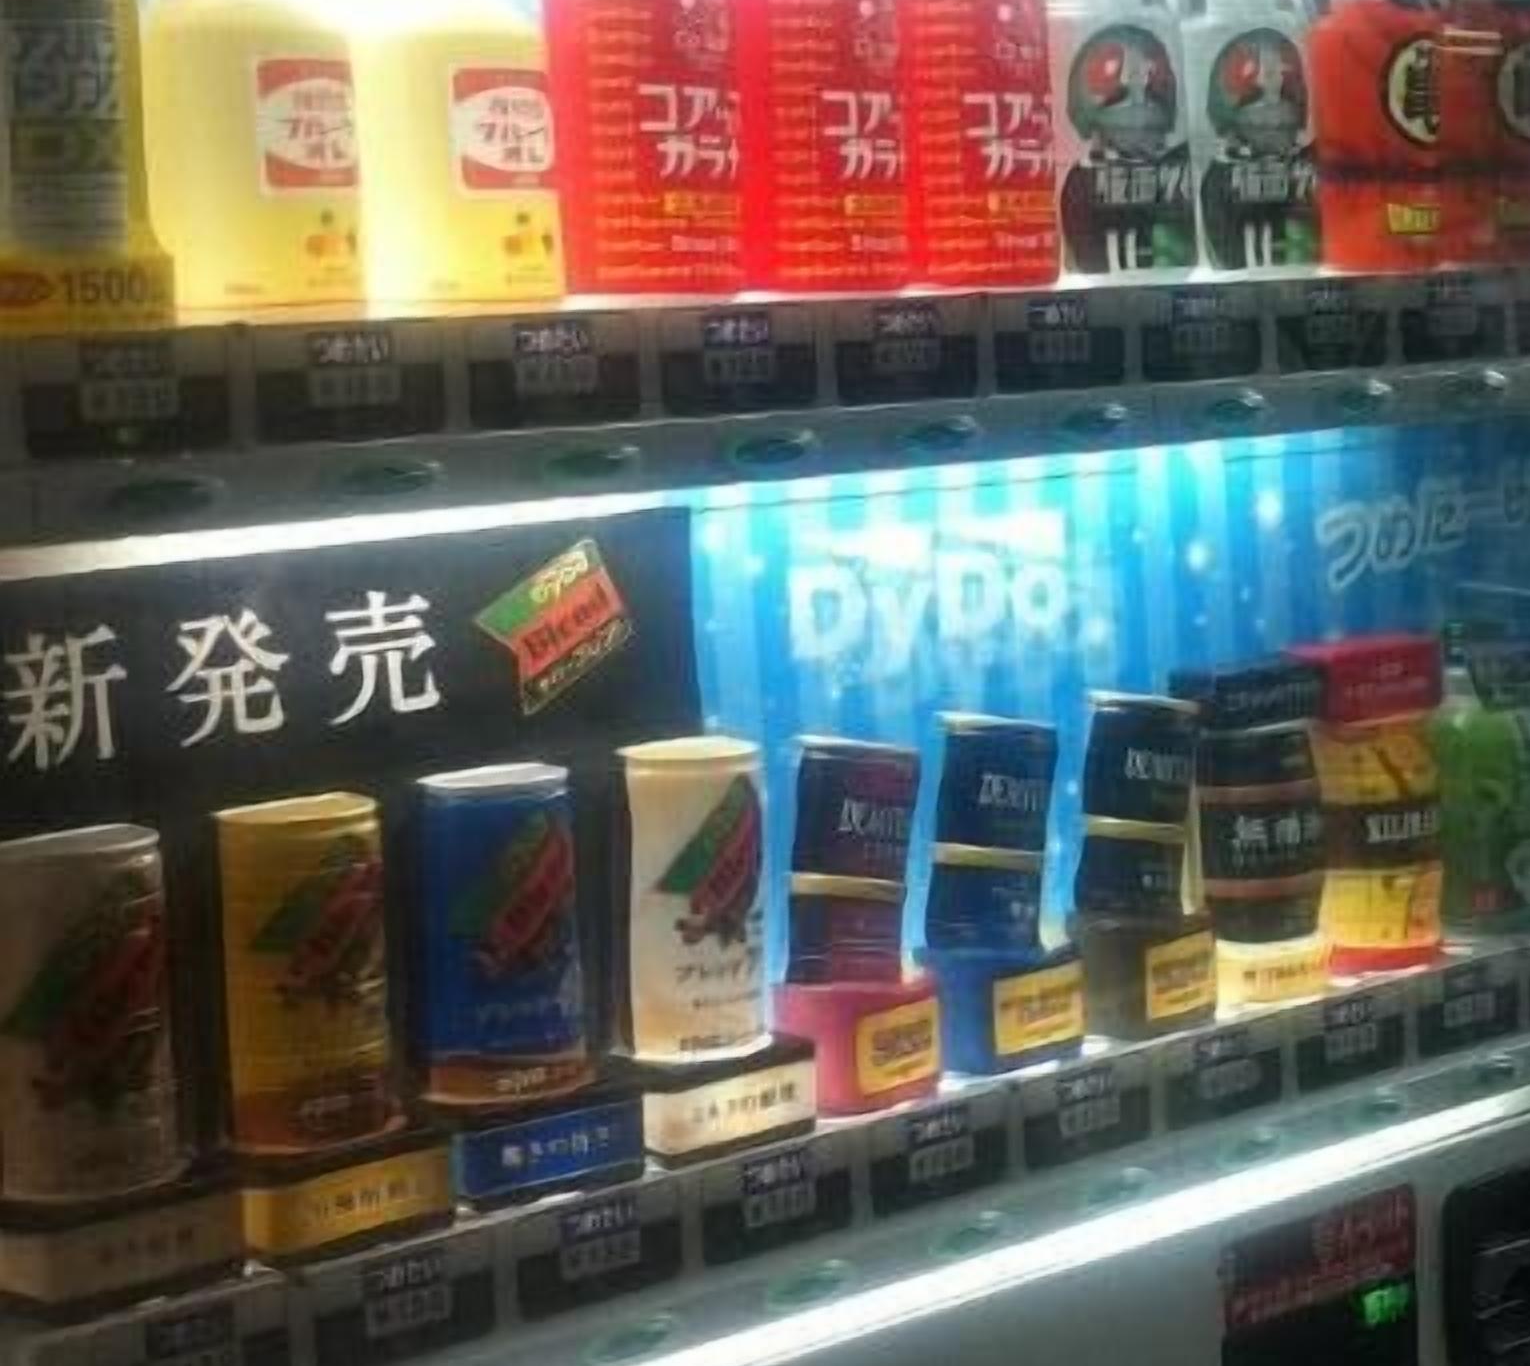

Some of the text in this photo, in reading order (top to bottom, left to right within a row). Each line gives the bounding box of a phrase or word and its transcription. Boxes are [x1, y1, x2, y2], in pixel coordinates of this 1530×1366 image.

[2, 589, 442, 769] 新発売
[788, 547, 1072, 677] DyDo
